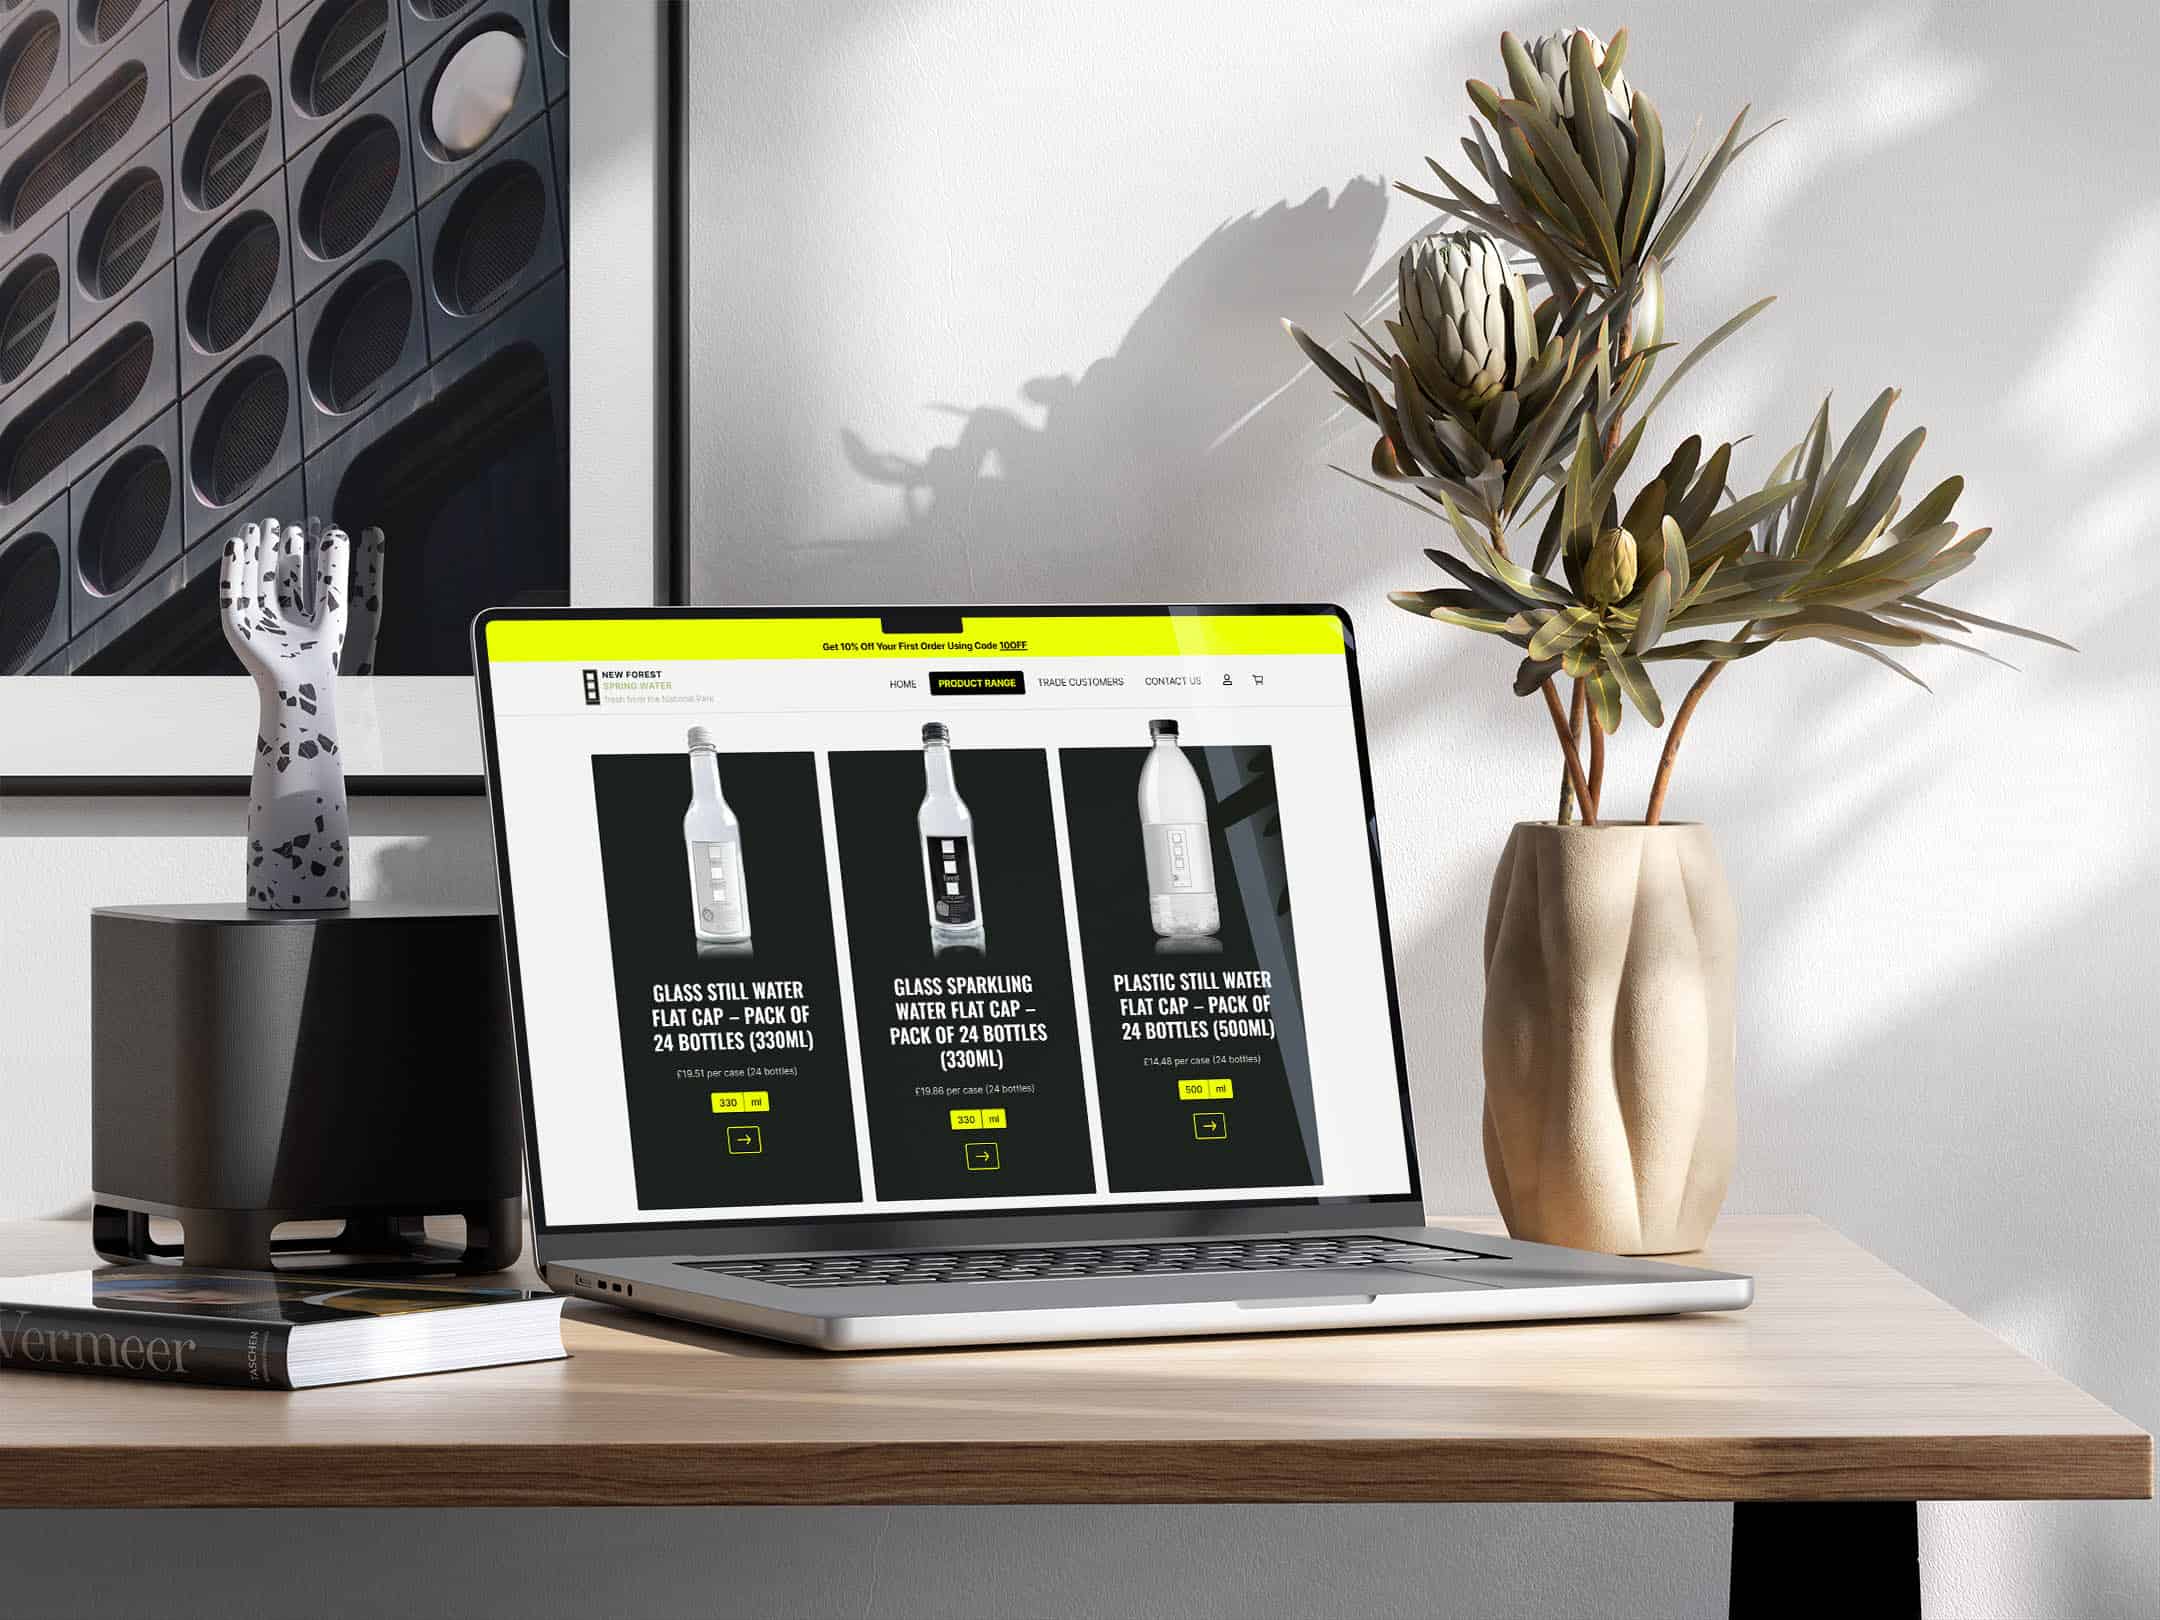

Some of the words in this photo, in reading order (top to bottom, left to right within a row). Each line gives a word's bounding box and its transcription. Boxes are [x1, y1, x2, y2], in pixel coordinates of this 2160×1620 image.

[822, 642, 838, 651] Get
[840, 642, 858, 651] 10%
[860, 642, 874, 650] Off
[876, 642, 896, 650] Your
[898, 642, 919, 650] First
[921, 641, 945, 650] Order
[948, 641, 973, 651] Using
[975, 641, 997, 650] Code
[602, 671, 623, 679] NEW
[626, 671, 662, 679] FOREST
[1038, 678, 1067, 687] TRADE
[1068, 677, 1124, 686] CUSTOMERS
[1144, 677, 1186, 686] CONTACT
[1189, 677, 1201, 686] US
[603, 682, 637, 690] SPRING
[890, 680, 917, 688] HOME
[938, 679, 982, 688] PRODUCT
[984, 679, 1016, 687] RANGE
[894, 977, 942, 996] GLASS
[947, 975, 1033, 995] SPARKLING
[1114, 974, 1176, 992] PLASTIC
[1180, 972, 1219, 991] STILL
[1223, 970, 1272, 989] WATER
[653, 984, 703, 1002] GLASS
[707, 982, 749, 1001] STILL
[752, 981, 804, 1000] WATER
[896, 1002, 946, 1020] WATER
[951, 1001, 984, 1019] FLAT
[989, 1000, 1020, 1018] CAP
[1120, 998, 1153, 1016] FLAT
[1158, 997, 1189, 1015] CAP
[1208, 995, 1249, 1014] PACK
[1252, 994, 1271, 1013] OF
[652, 1009, 687, 1027] FLAT
[692, 1008, 723, 1026] CAP
[744, 1006, 786, 1025] PACK
[791, 1005, 809, 1023] OF
[890, 1026, 932, 1045] PACK
[935, 1026, 955, 1044] OF
[960, 1025, 978, 1043] 24
[983, 1023, 1048, 1042] BOTTLES
[1122, 1023, 1142, 1041] 24
[1146, 1020, 1209, 1040] BOTTLES
[1213, 1019, 1275, 1041] (500ML)
[654, 1033, 674, 1052] 24
[678, 1032, 744, 1052] BOTTLES
[749, 1030, 814, 1053] (330ML)
[940, 1049, 1003, 1072] (330ML)
[1174, 1057, 1188, 1067] per
[1190, 1056, 1210, 1065] case
[1212, 1055, 1227, 1065] (24
[1228, 1054, 1261, 1064] bottles)
[707, 1070, 722, 1080] per
[724, 1069, 744, 1077] case
[747, 1067, 762, 1077] (24
[763, 1066, 798, 1077] bottles)
[946, 1087, 960, 1096] per
[962, 1086, 983, 1095] case
[985, 1084, 1000, 1095] (24
[1002, 1083, 1035, 1094] bottles)
[1185, 1085, 1203, 1094] 500
[1216, 1085, 1226, 1093] ml
[719, 1098, 737, 1107] 330
[751, 1098, 762, 1107] ml
[957, 1115, 975, 1124] 330
[989, 1114, 1000, 1124] ml
[0, 1309, 197, 1373] Vermeer
[248, 1331, 260, 1380] TASCHEN
